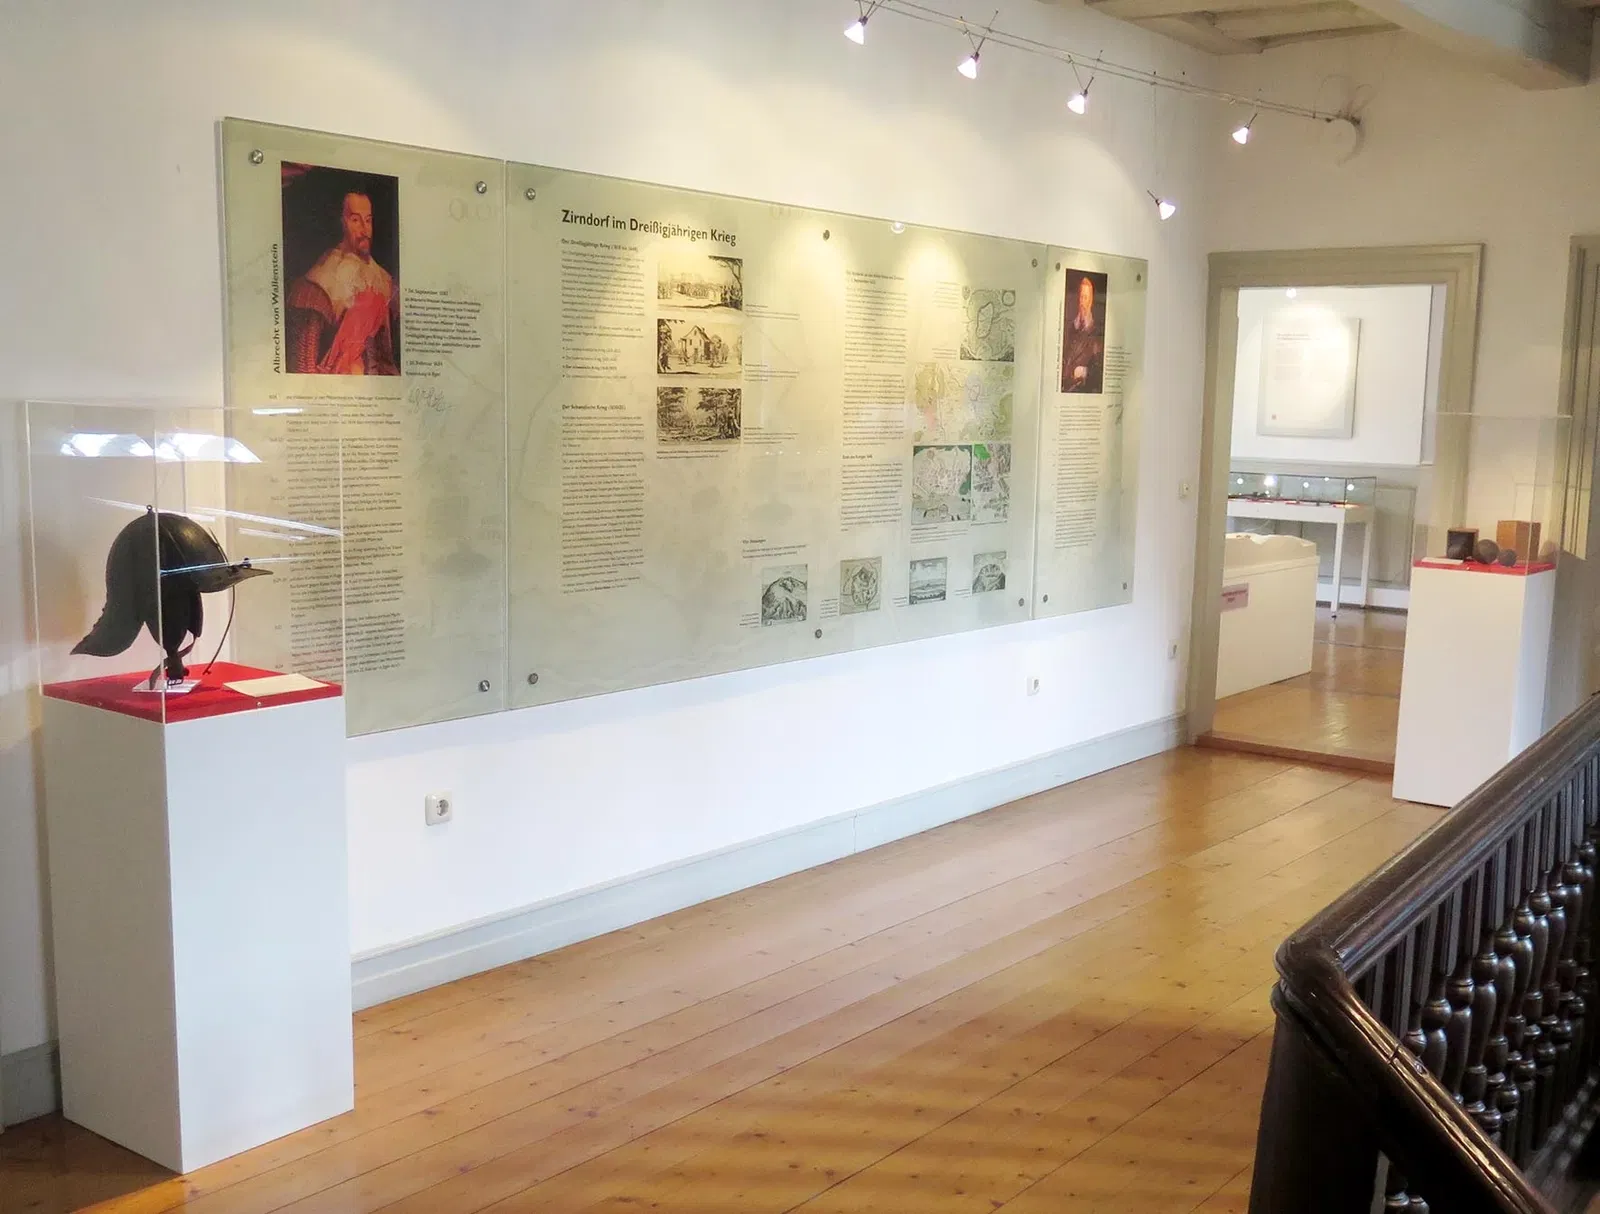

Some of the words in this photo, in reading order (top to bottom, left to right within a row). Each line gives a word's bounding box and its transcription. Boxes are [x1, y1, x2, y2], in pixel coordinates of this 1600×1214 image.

[561, 209, 610, 228] Zirndorf
[612, 216, 627, 230] im
[630, 218, 708, 242] Dreißigjährigen
[711, 229, 737, 247] Krieg
[270, 243, 279, 305] Wallenstein
[272, 307, 280, 326] von
[273, 327, 281, 374] Albrecht
